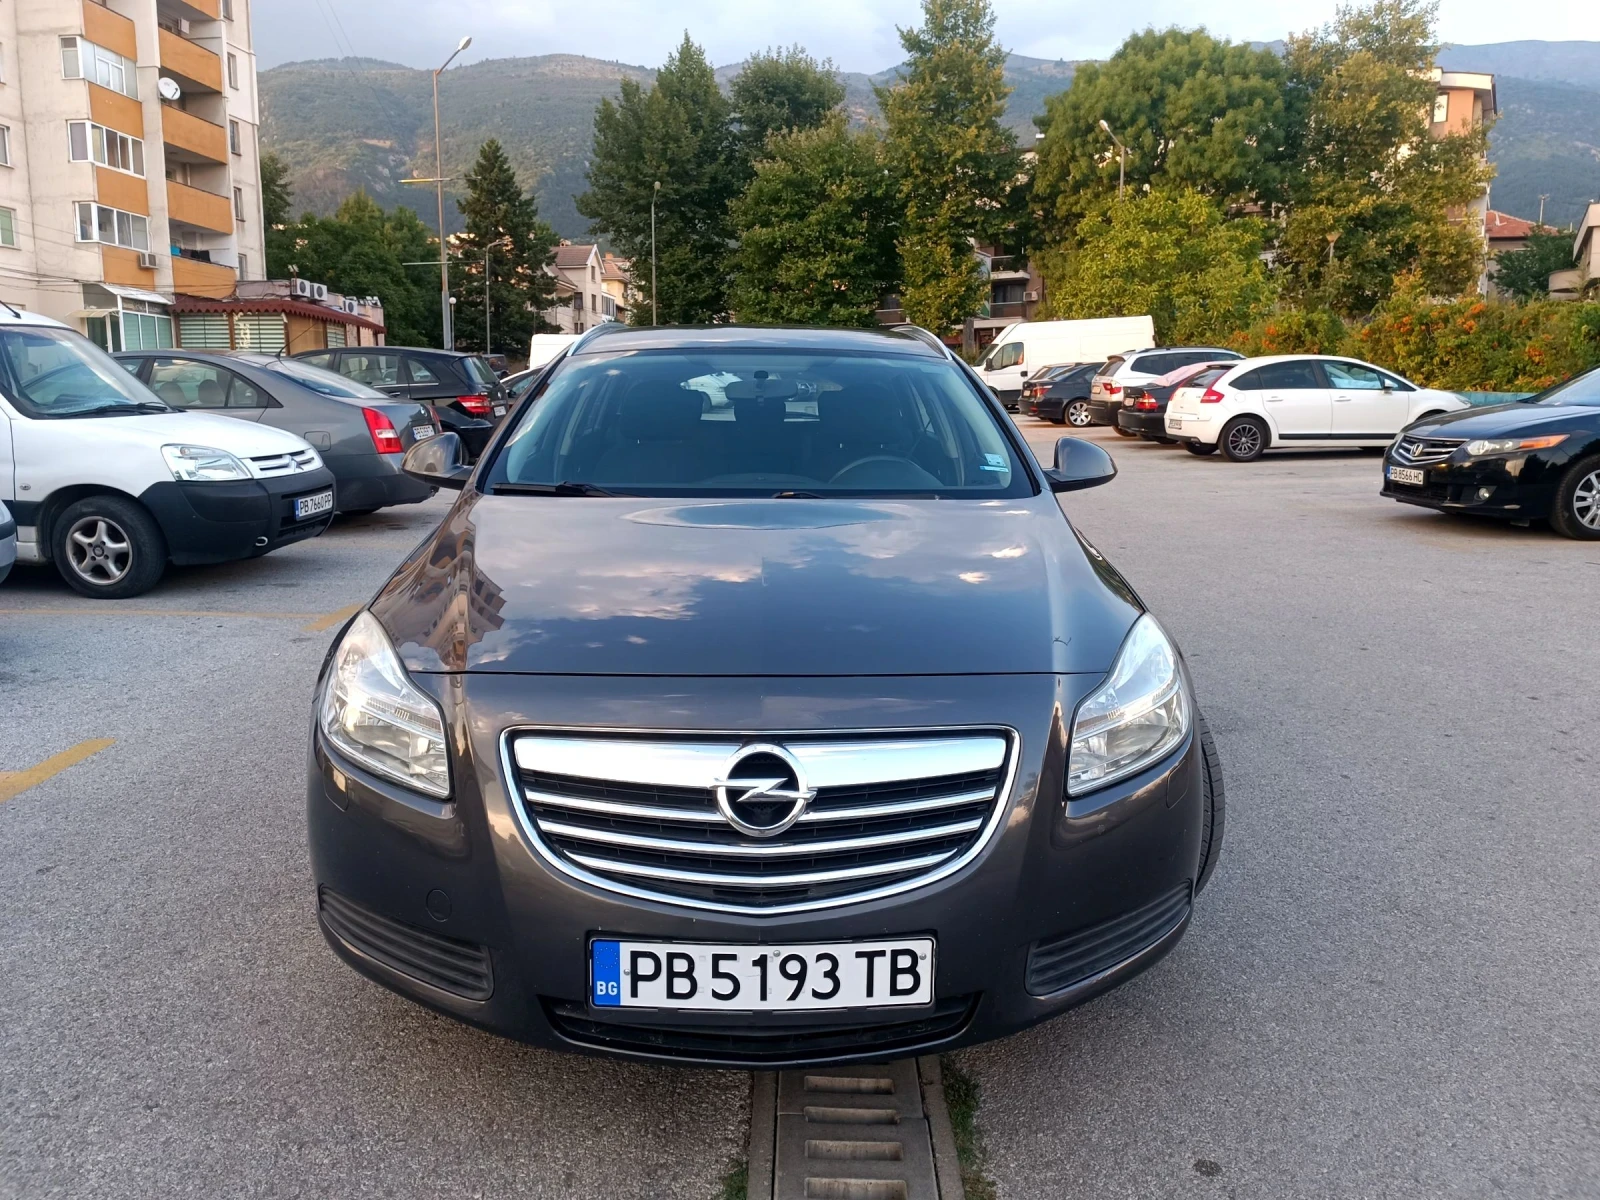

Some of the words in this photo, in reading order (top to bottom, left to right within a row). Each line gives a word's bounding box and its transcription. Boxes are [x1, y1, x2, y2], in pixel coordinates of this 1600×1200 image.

[299, 500, 309, 514] PB
[629, 950, 698, 999] PB
[711, 952, 841, 1001] 5193
[854, 948, 921, 997] TB
[596, 981, 619, 996] BG
